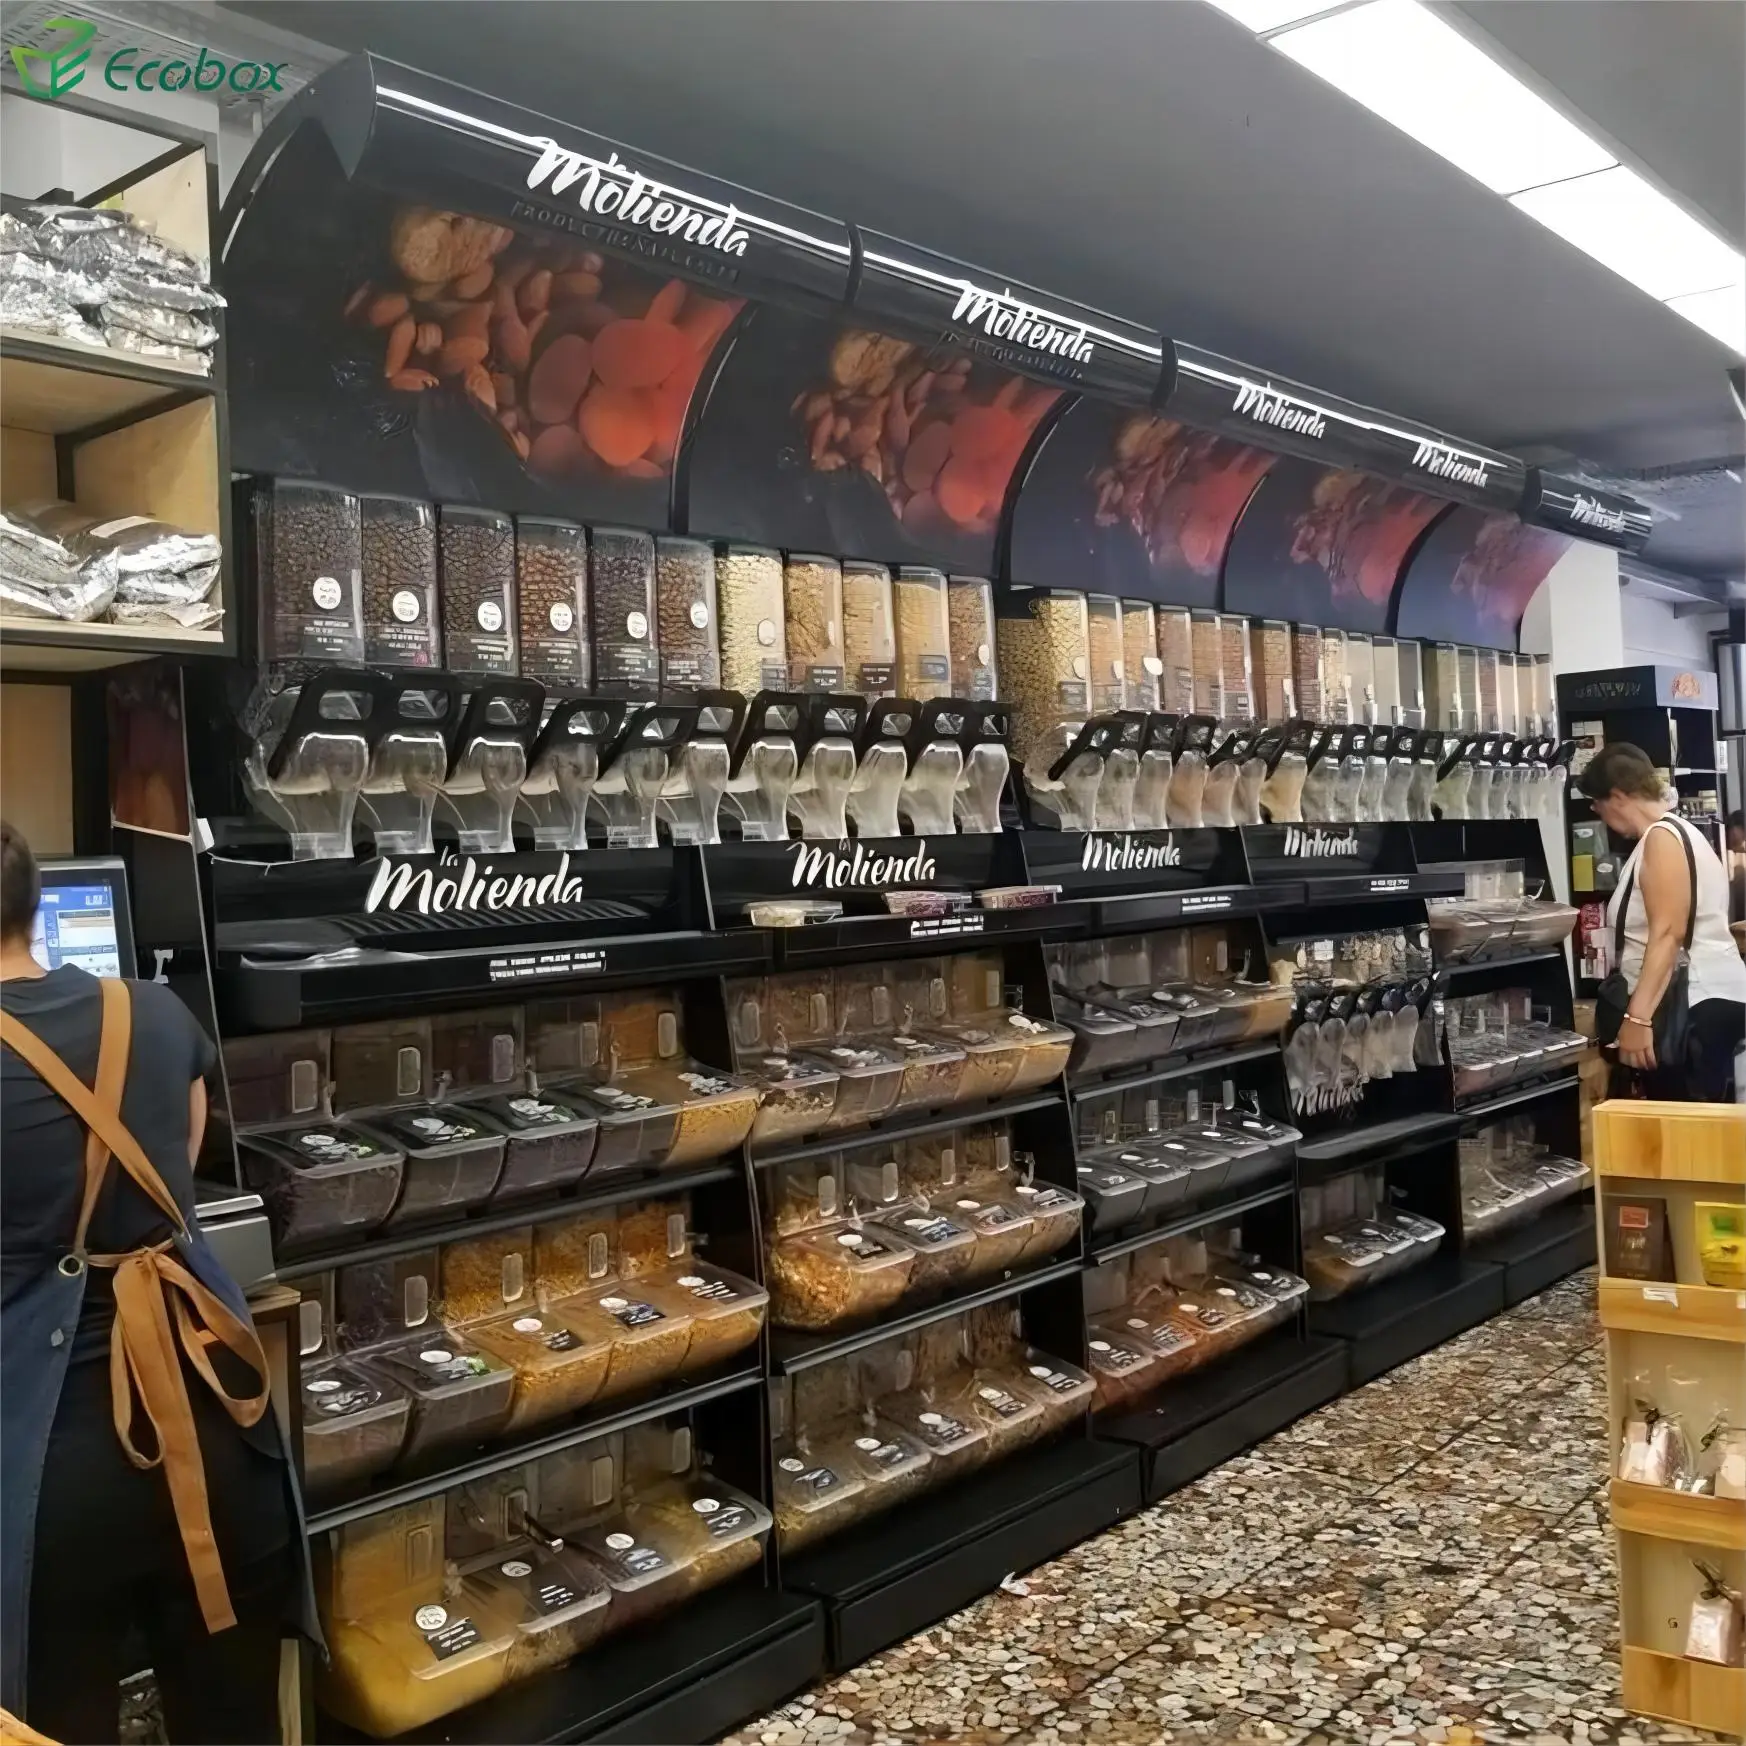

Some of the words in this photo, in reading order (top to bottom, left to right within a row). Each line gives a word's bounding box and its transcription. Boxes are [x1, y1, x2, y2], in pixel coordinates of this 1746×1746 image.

[526, 136, 750, 257] Molienda
[364, 854, 584, 915] Molienda
[785, 838, 936, 889] Molienda
